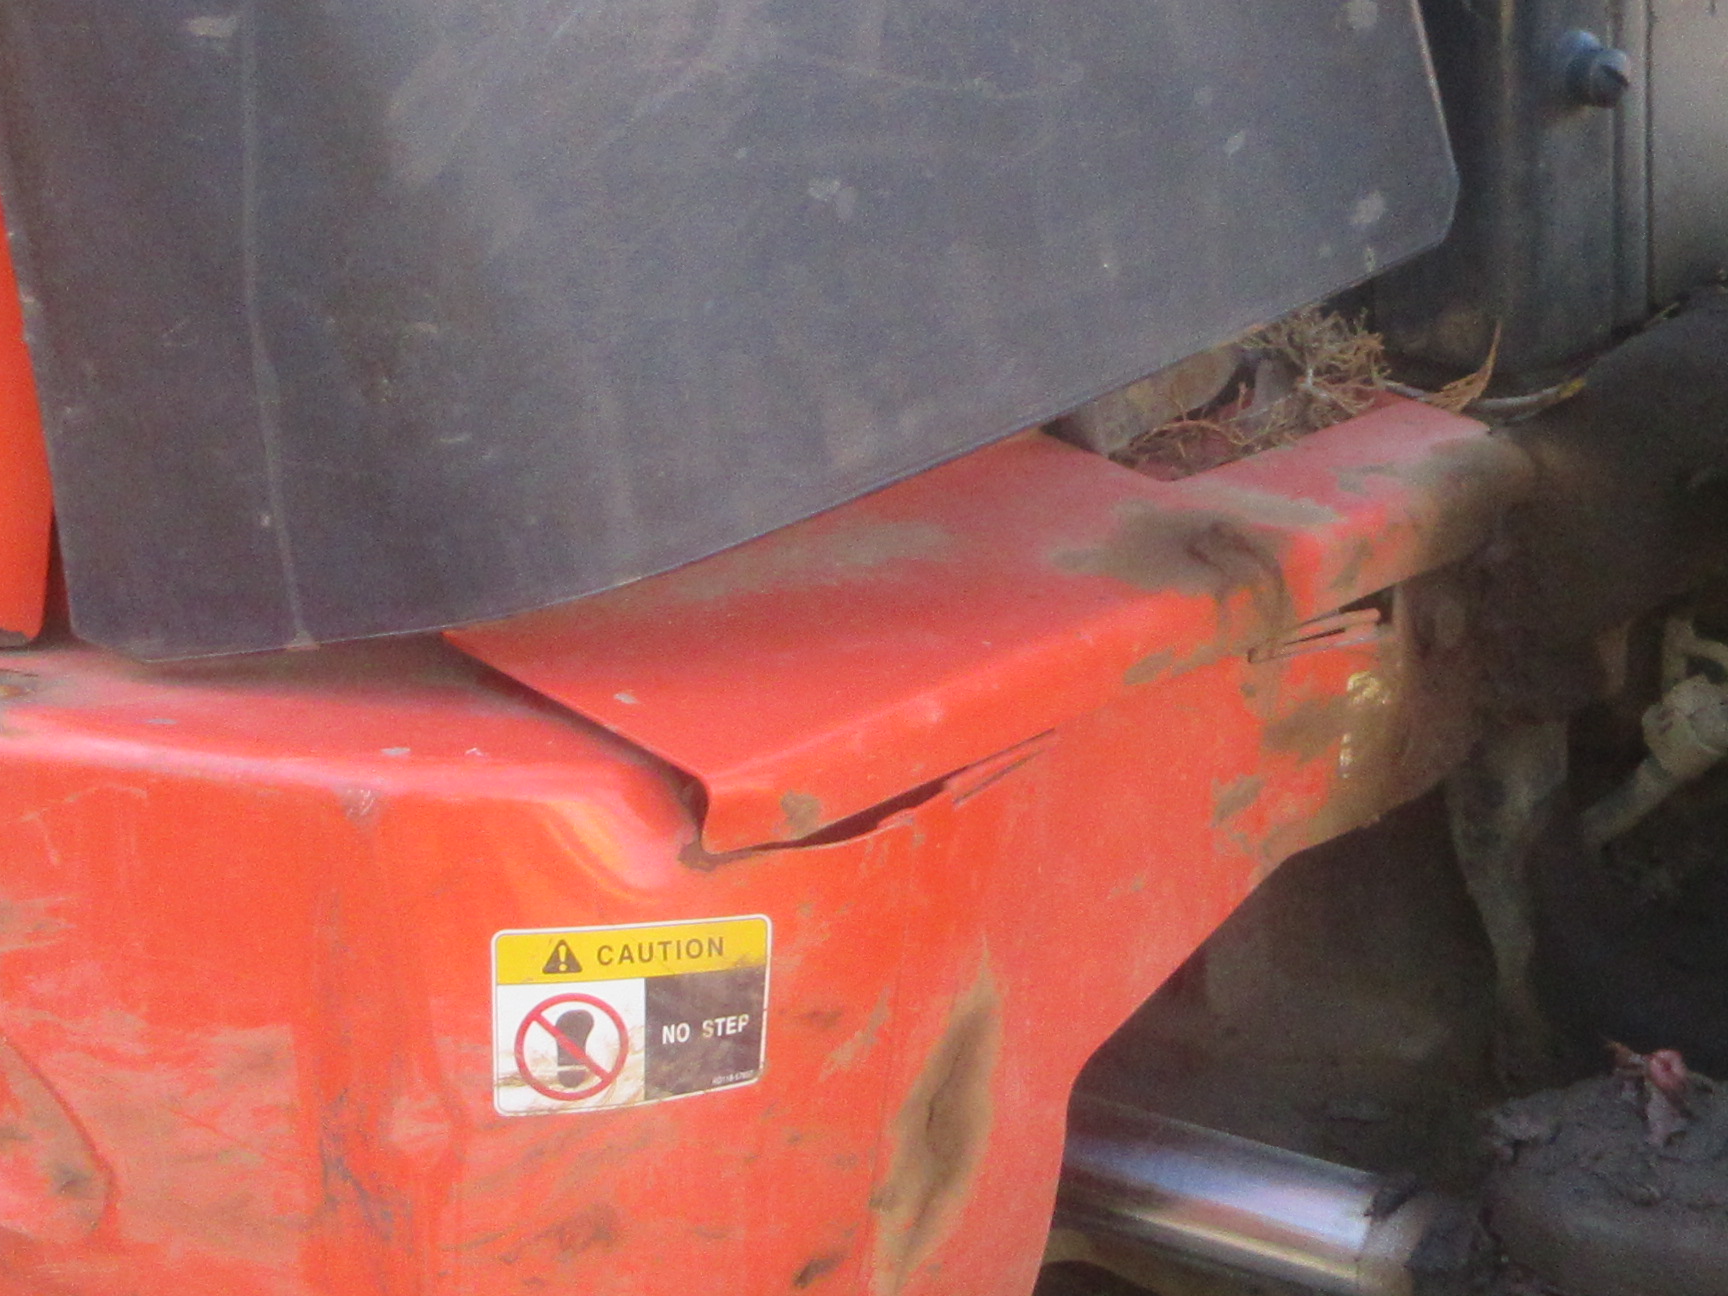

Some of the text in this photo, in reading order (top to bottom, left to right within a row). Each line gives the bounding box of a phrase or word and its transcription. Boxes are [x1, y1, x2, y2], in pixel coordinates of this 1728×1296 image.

[596, 936, 724, 966] CAUTION
[661, 1012, 750, 1045] NO STEP
